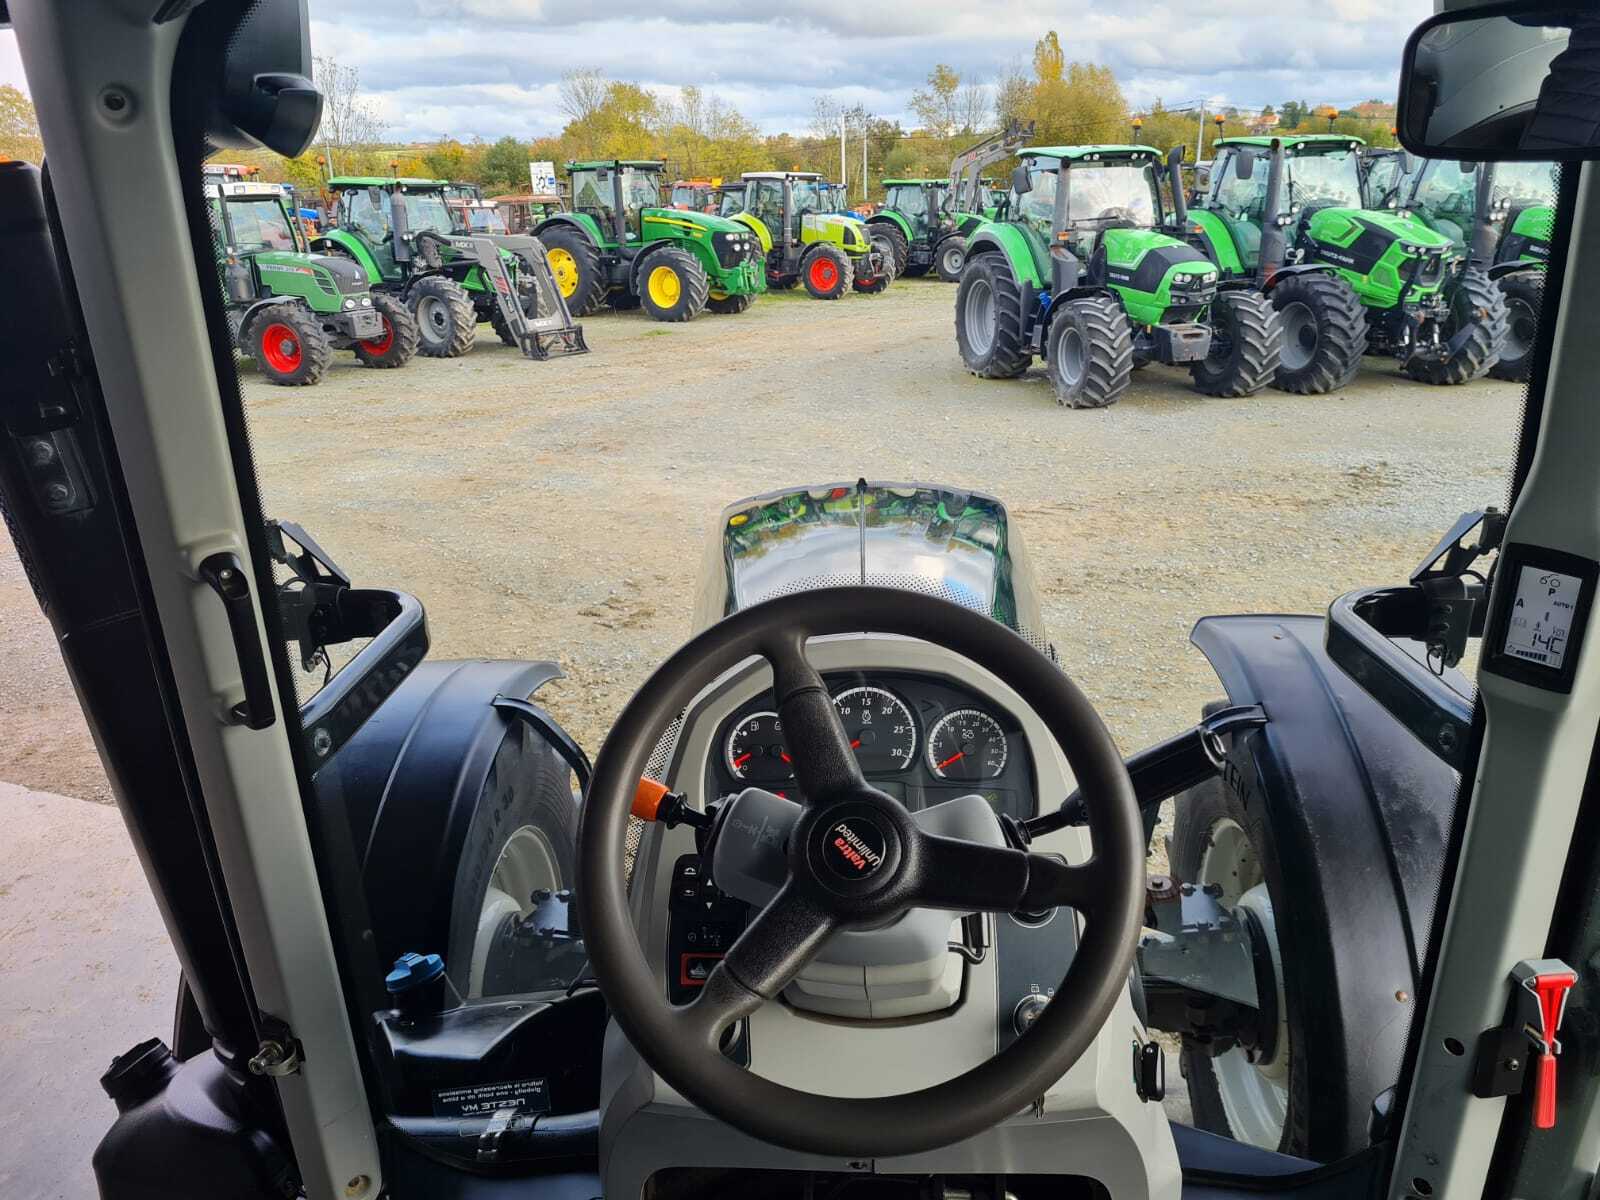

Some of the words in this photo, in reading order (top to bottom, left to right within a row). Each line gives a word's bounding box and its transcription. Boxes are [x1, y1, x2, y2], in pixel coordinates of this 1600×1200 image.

[1548, 588, 1556, 597] P
[1516, 598, 1524, 608] A
[861, 698, 872, 706] 15
[840, 707, 851, 715] 10
[881, 707, 893, 715] 20
[893, 725, 905, 734] 25
[890, 748, 902, 757] 30
[834, 823, 881, 867] Unlimited
[834, 837, 866, 870] Valtra
